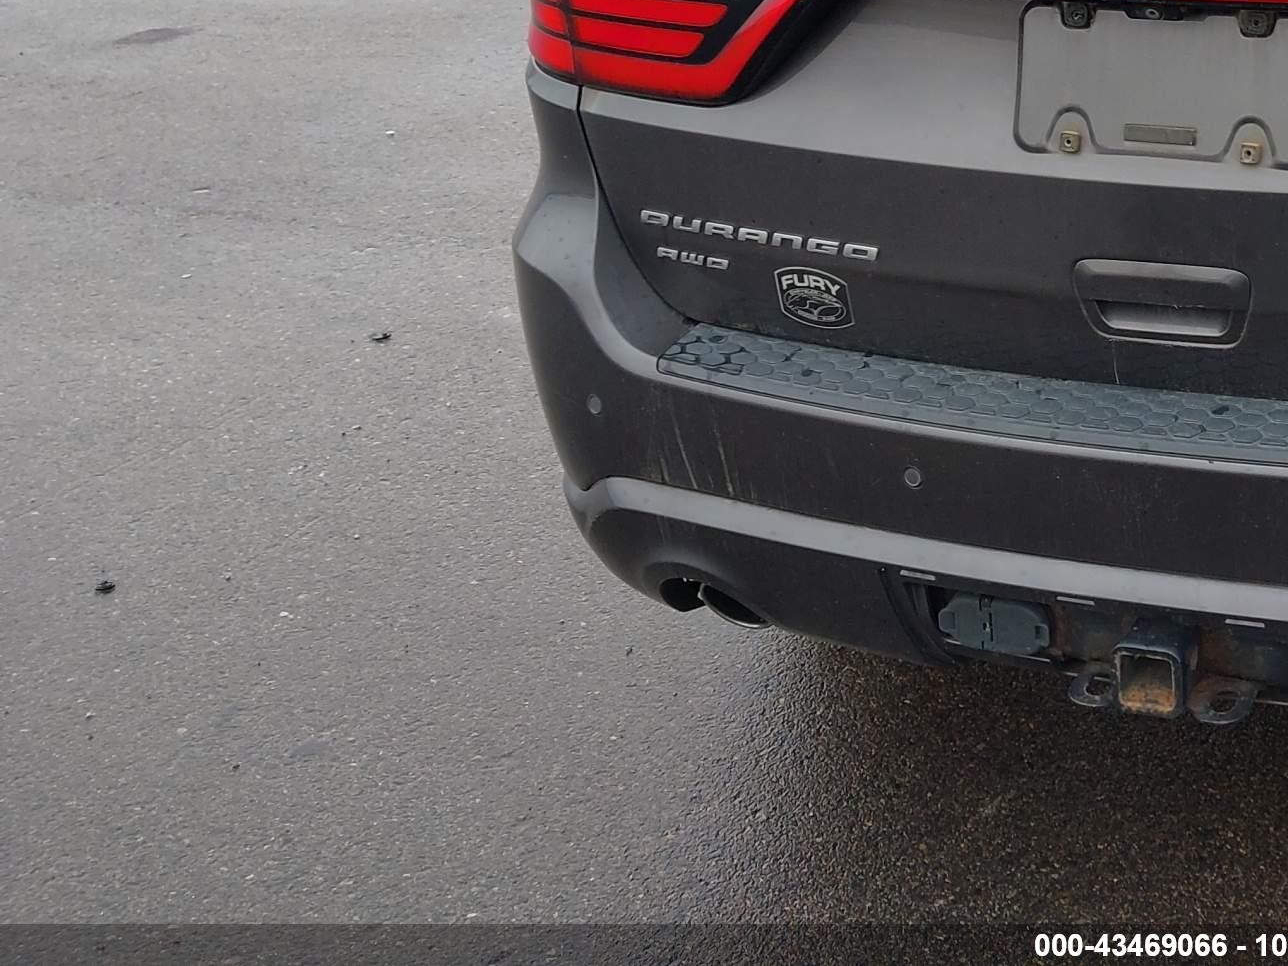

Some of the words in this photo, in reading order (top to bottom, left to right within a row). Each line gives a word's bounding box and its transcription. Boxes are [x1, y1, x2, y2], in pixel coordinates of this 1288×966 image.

[640, 209, 879, 262] DURANGO
[657, 246, 729, 270] AWD
[781, 274, 840, 295] FURY
